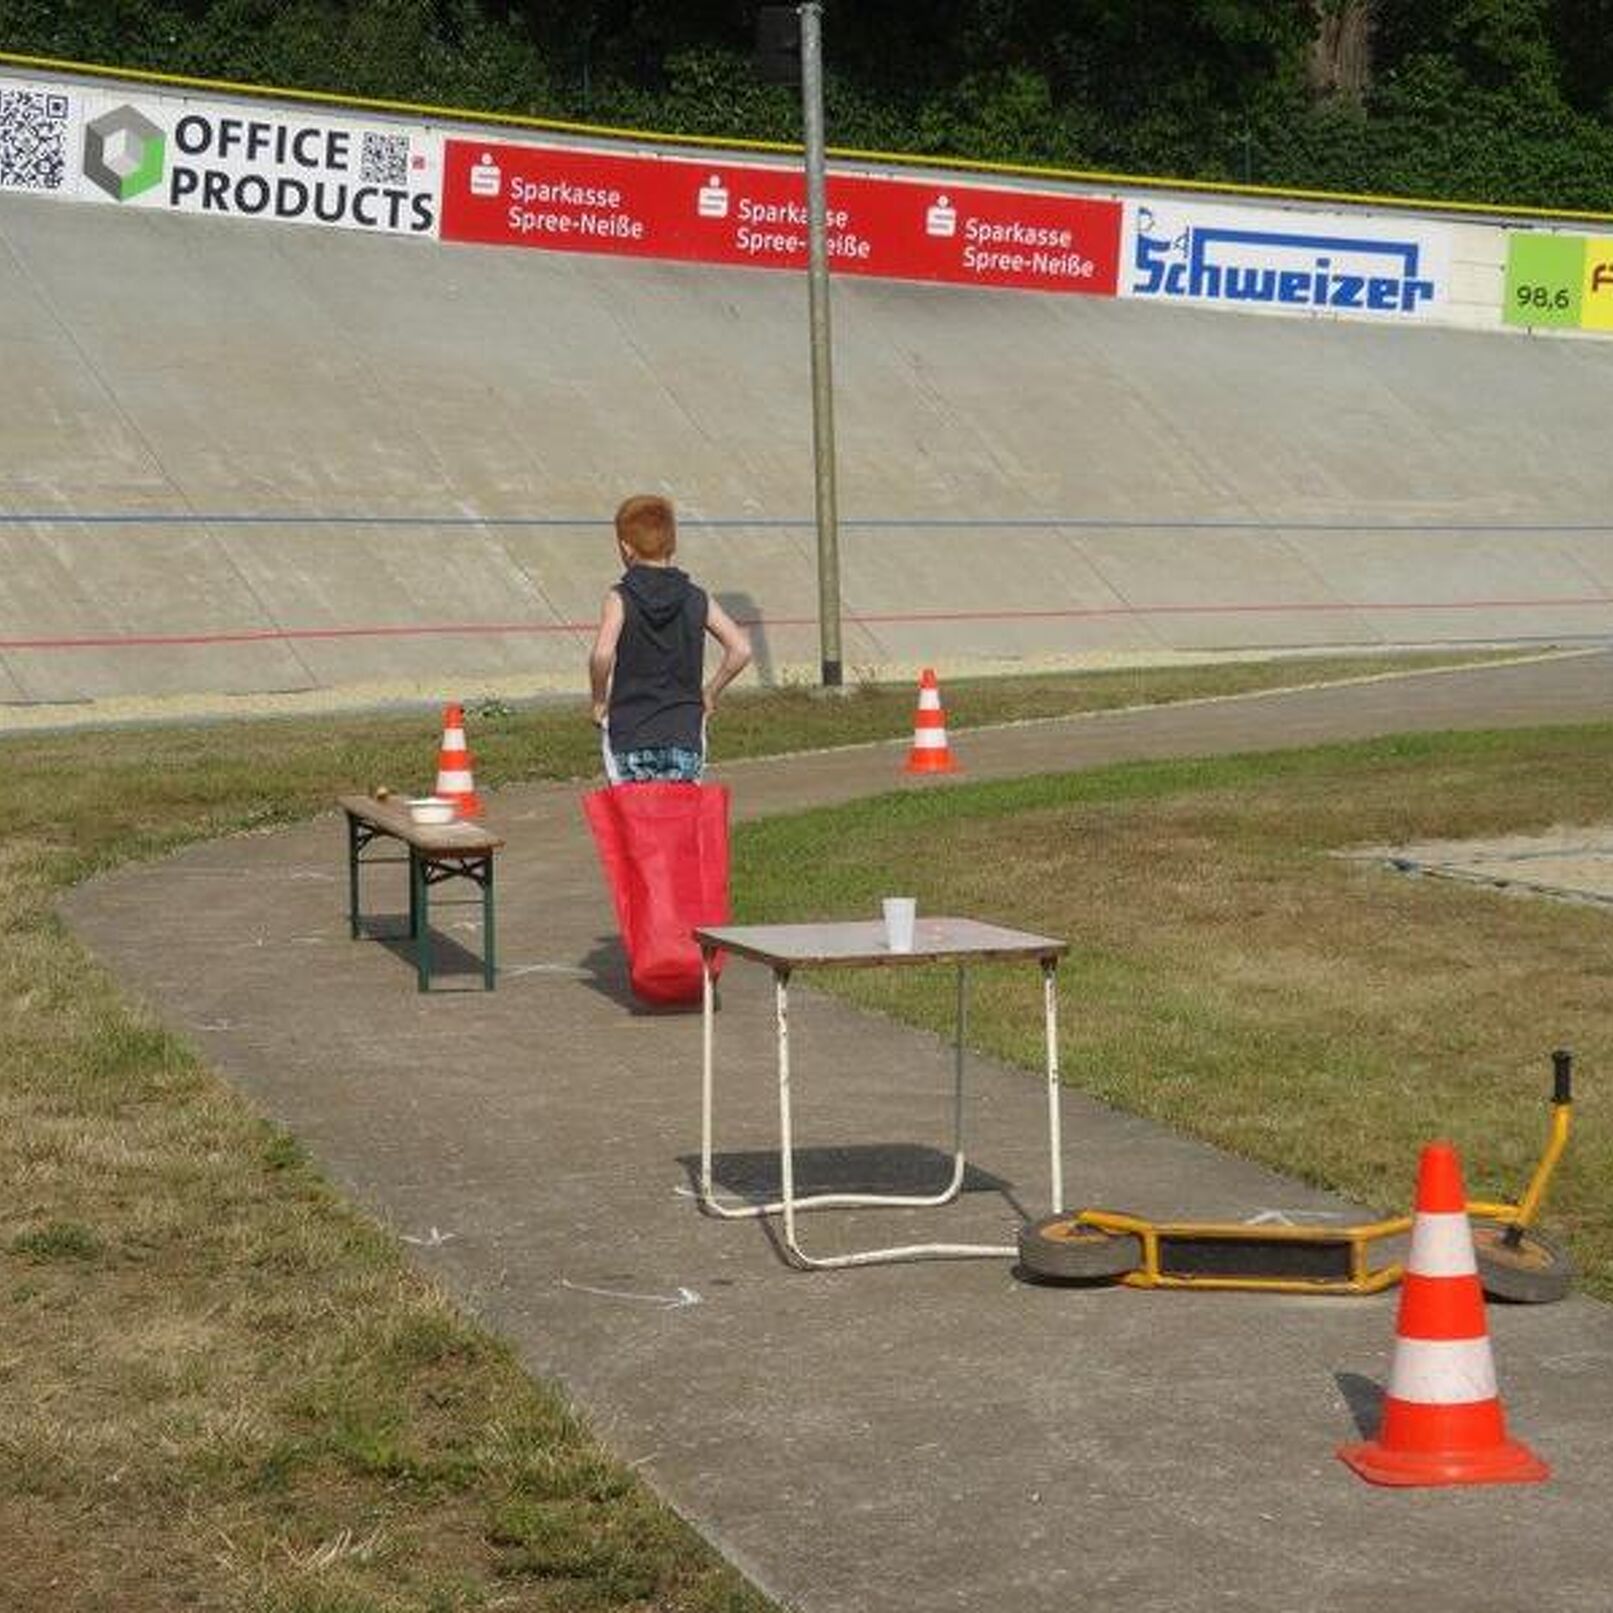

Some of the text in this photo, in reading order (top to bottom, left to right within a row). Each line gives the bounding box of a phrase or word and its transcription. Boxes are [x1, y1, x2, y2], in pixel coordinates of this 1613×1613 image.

[175, 114, 350, 170] OFFICE
[169, 167, 434, 231] PRODUCTS
[510, 176, 621, 209] Sparkasse
[508, 206, 644, 239] Spree-Neiße
[737, 198, 849, 229] Sparkase
[736, 227, 871, 258] Spree-eiße
[965, 217, 1072, 249] Sparkasse
[963, 246, 1094, 279] Spree-Neiße
[1132, 228, 1434, 312] Schweizer
[1516, 285, 1570, 311] 98,6
